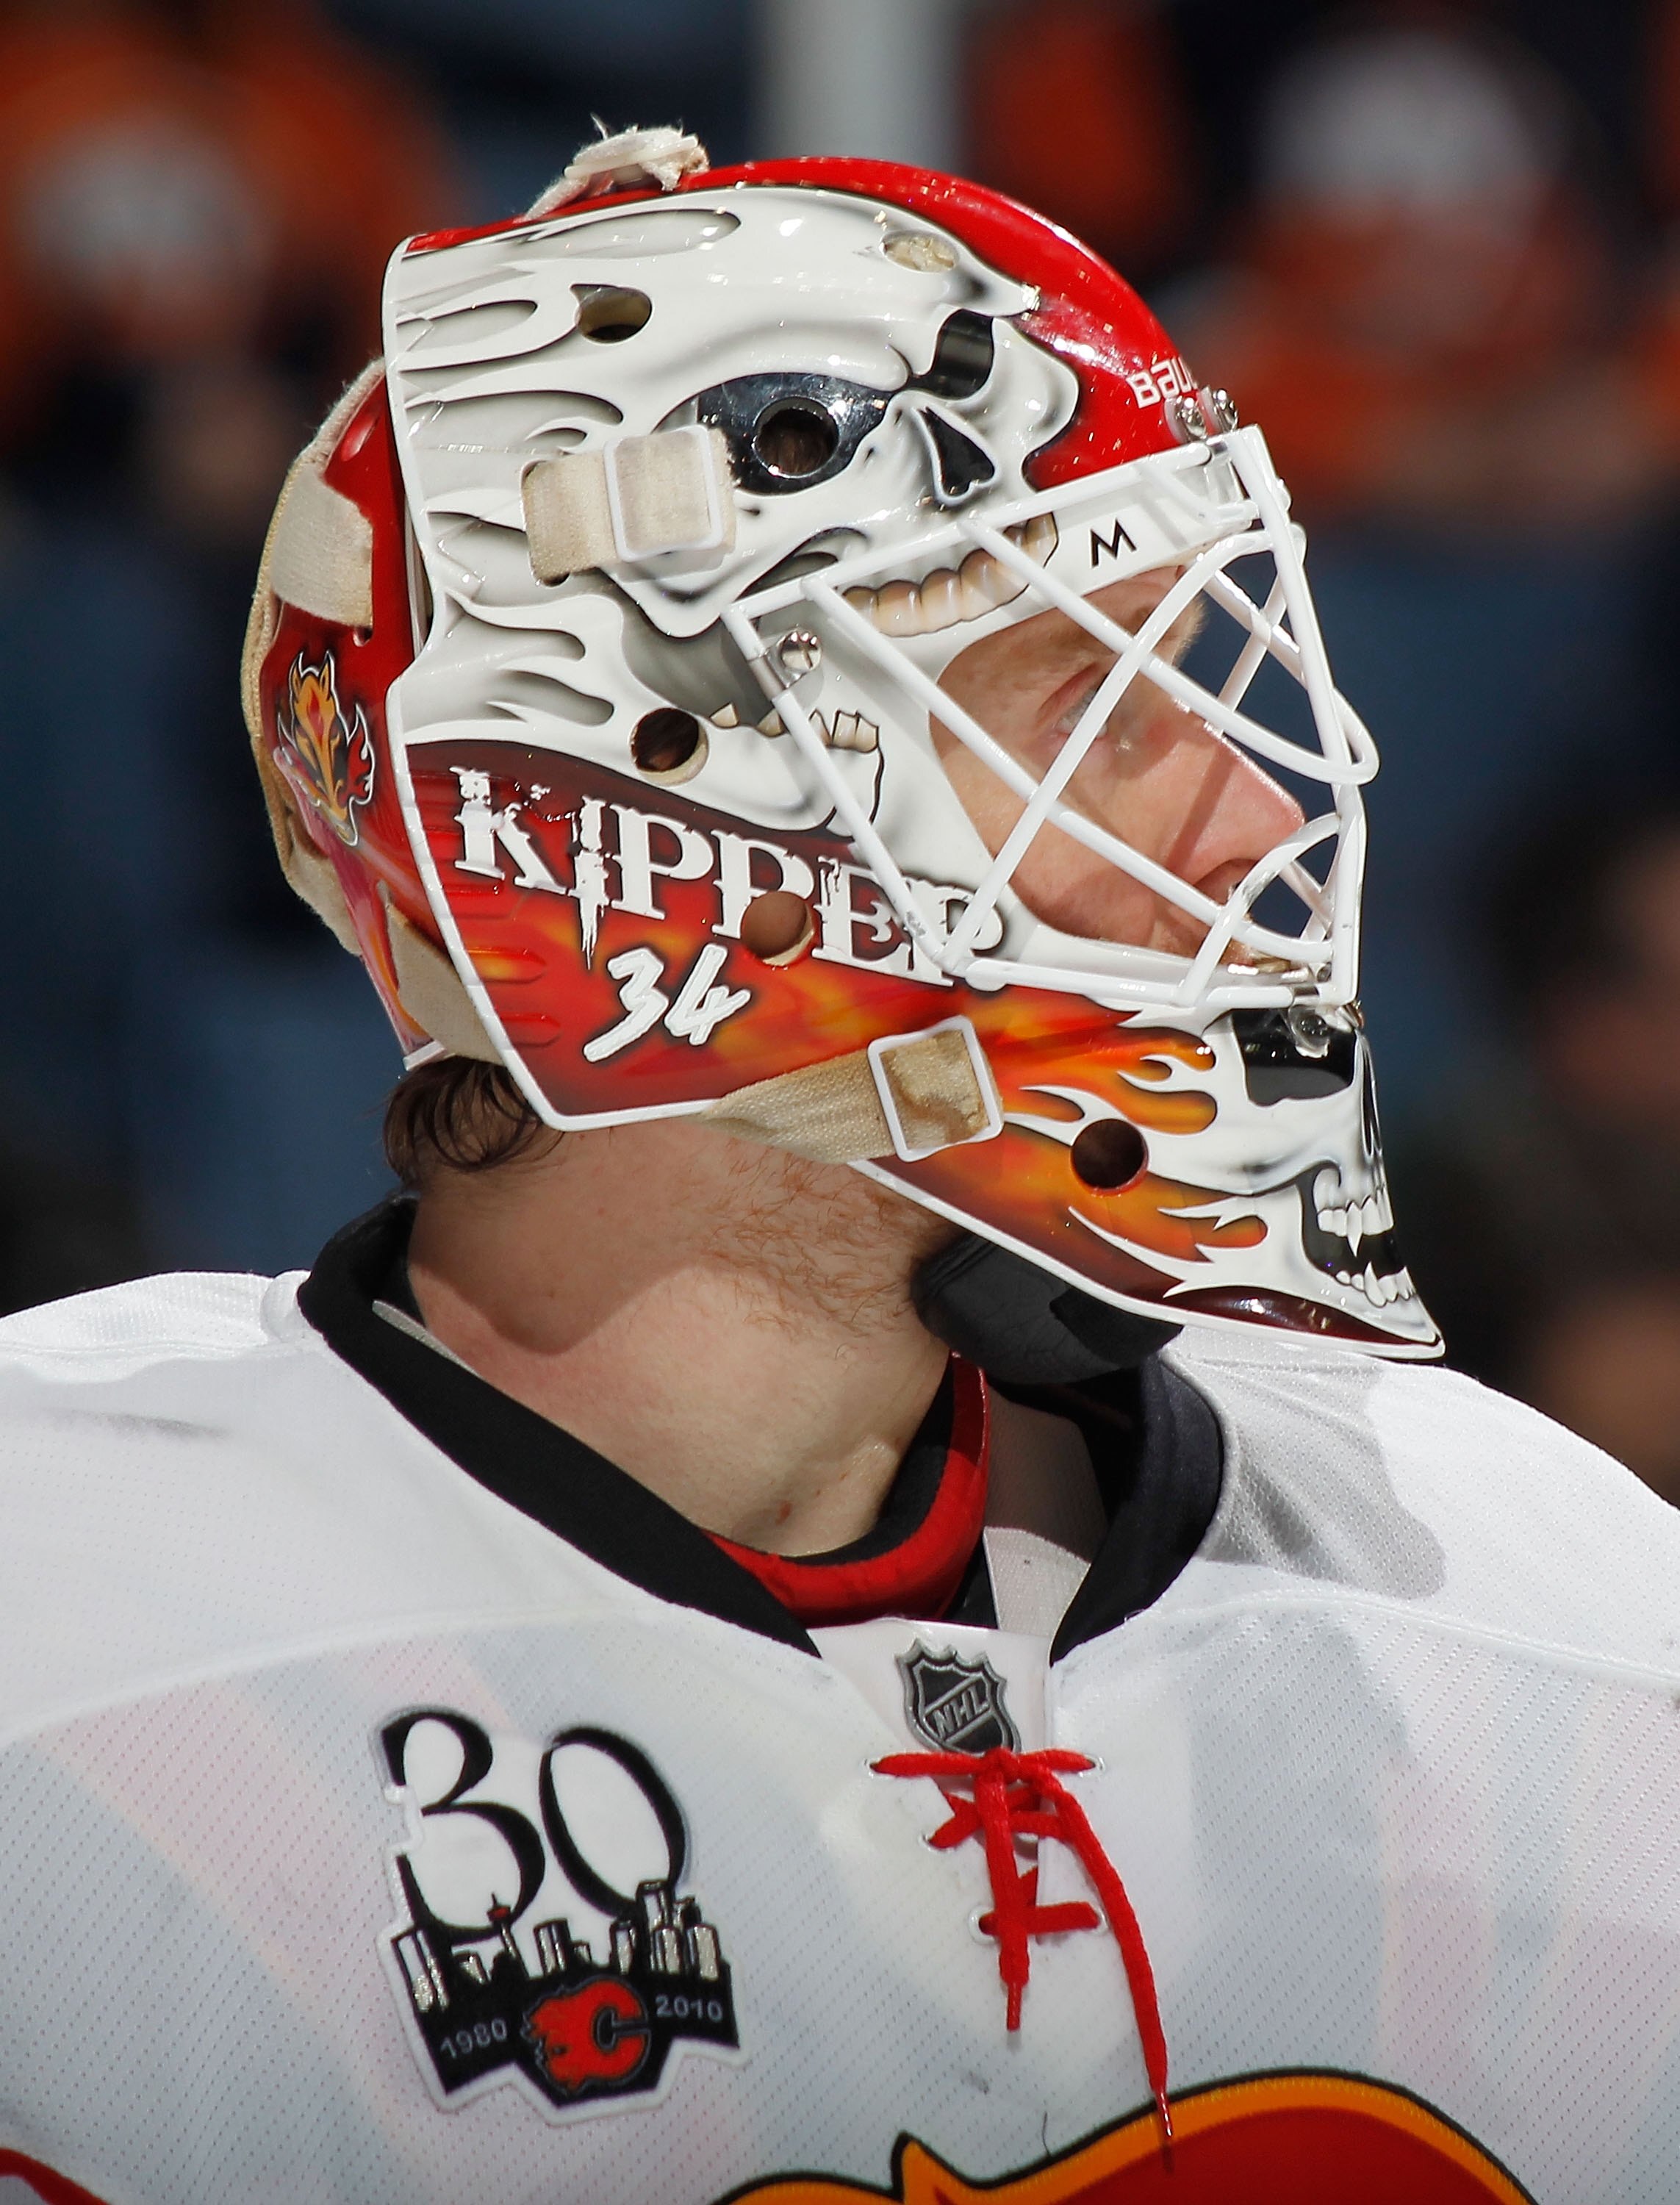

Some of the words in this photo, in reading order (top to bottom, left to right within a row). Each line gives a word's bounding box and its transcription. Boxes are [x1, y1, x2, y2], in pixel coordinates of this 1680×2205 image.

[1090, 517, 1137, 567] M
[583, 943, 751, 1063] 34
[932, 1684, 991, 1740] NHL
[381, 1711, 686, 1946] 30
[655, 1994, 723, 2023] 2010
[441, 2018, 508, 2059] 1980
